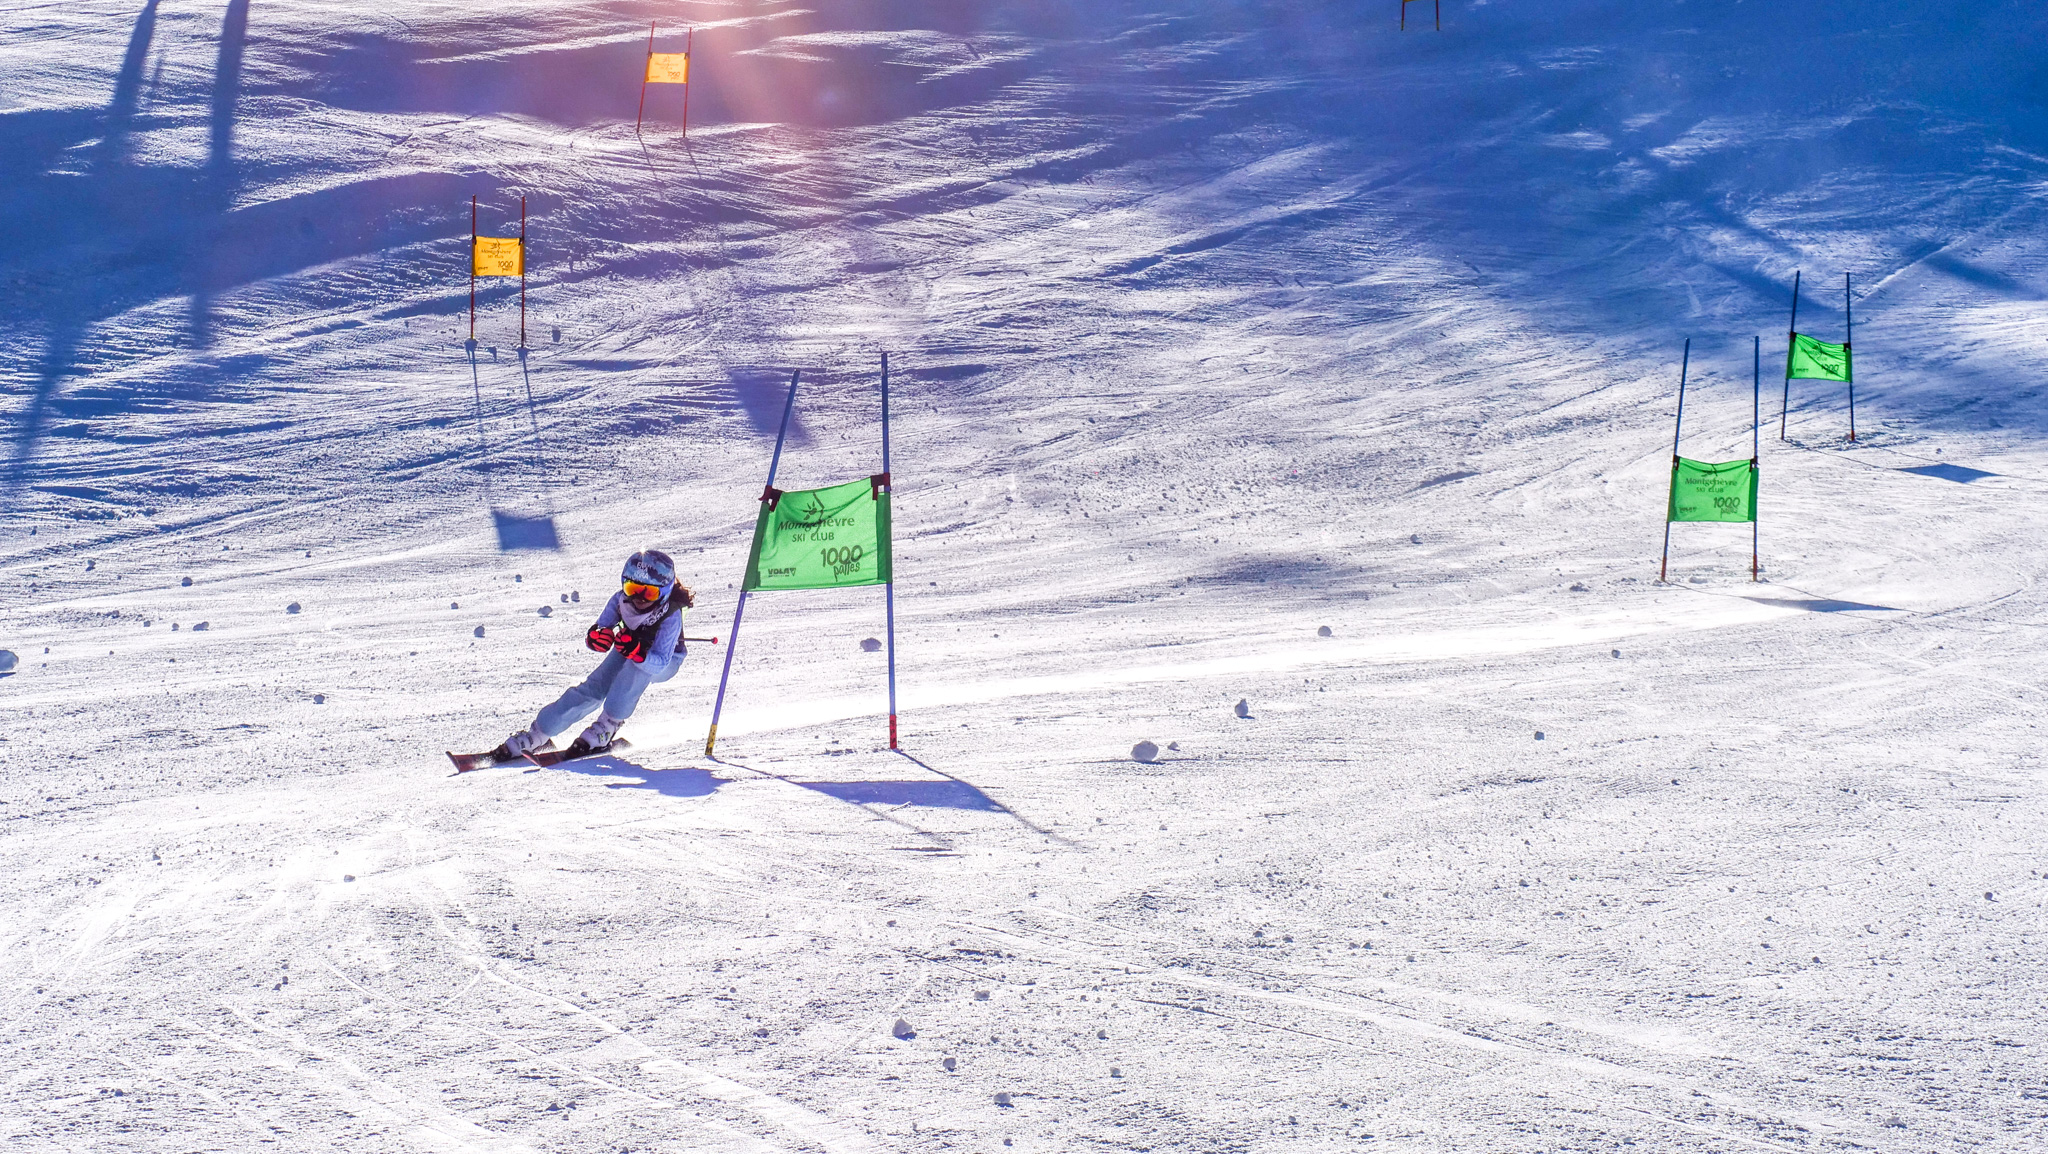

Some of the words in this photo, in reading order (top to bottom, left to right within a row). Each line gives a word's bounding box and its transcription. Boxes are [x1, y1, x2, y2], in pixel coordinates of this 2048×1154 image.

[1713, 497, 1740, 508] 1000
[792, 533, 806, 543] SKI
[810, 532, 835, 542] CLUB
[820, 545, 863, 567] 1000
[768, 567, 790, 575] VOLA
